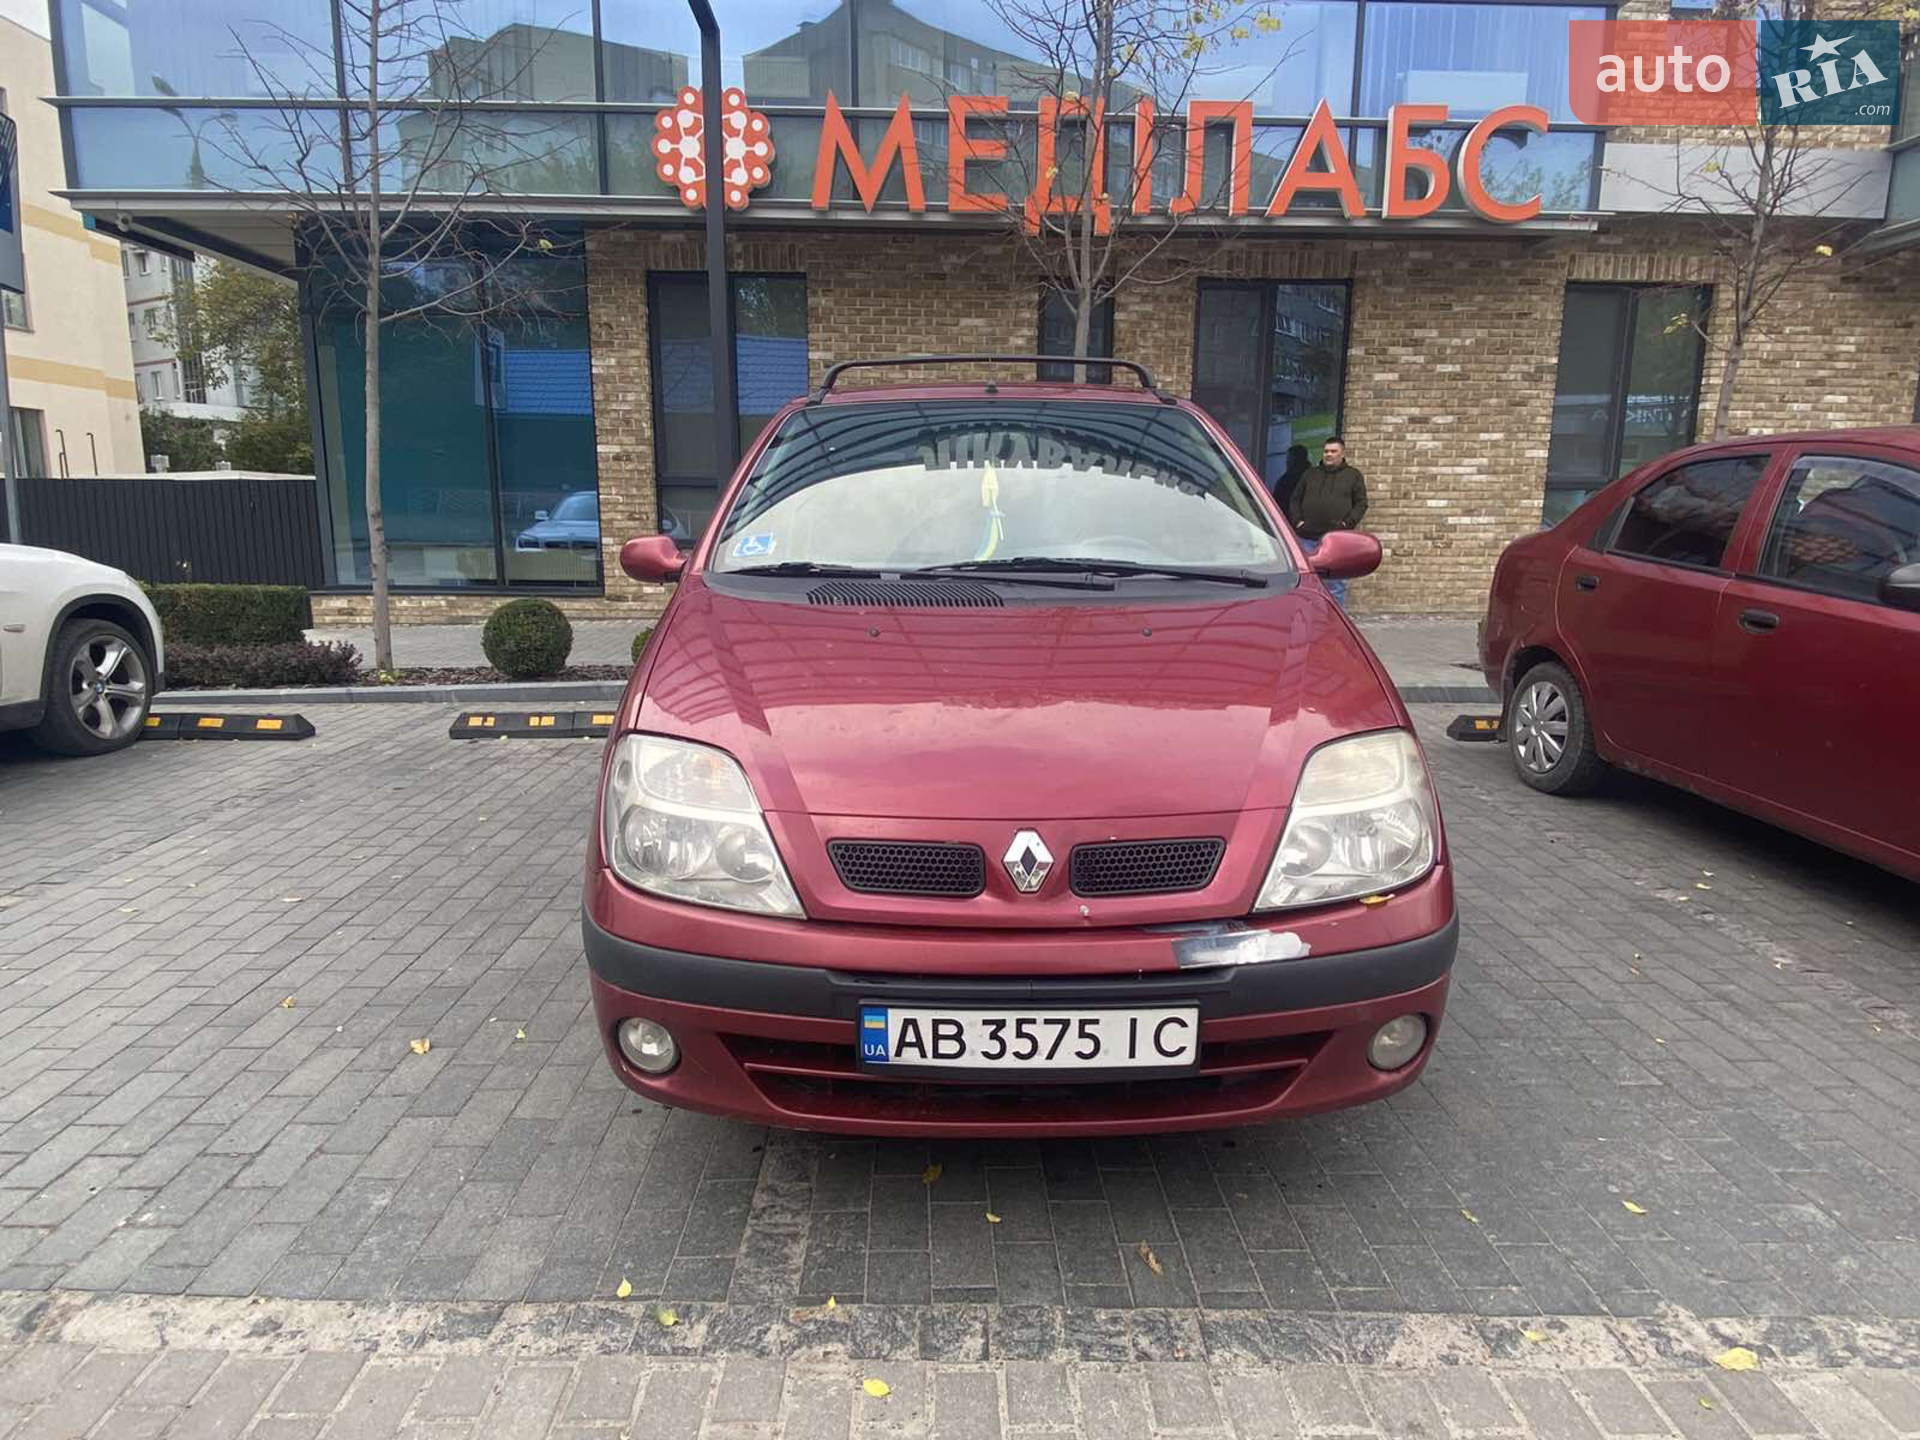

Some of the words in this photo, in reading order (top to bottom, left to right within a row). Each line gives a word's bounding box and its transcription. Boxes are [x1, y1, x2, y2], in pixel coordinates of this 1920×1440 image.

[810, 88, 1550, 237] МЕДІЛАБС
[864, 1043, 886, 1057] UA
[894, 1017, 967, 1060] AB
[980, 1018, 1101, 1061] 3575
